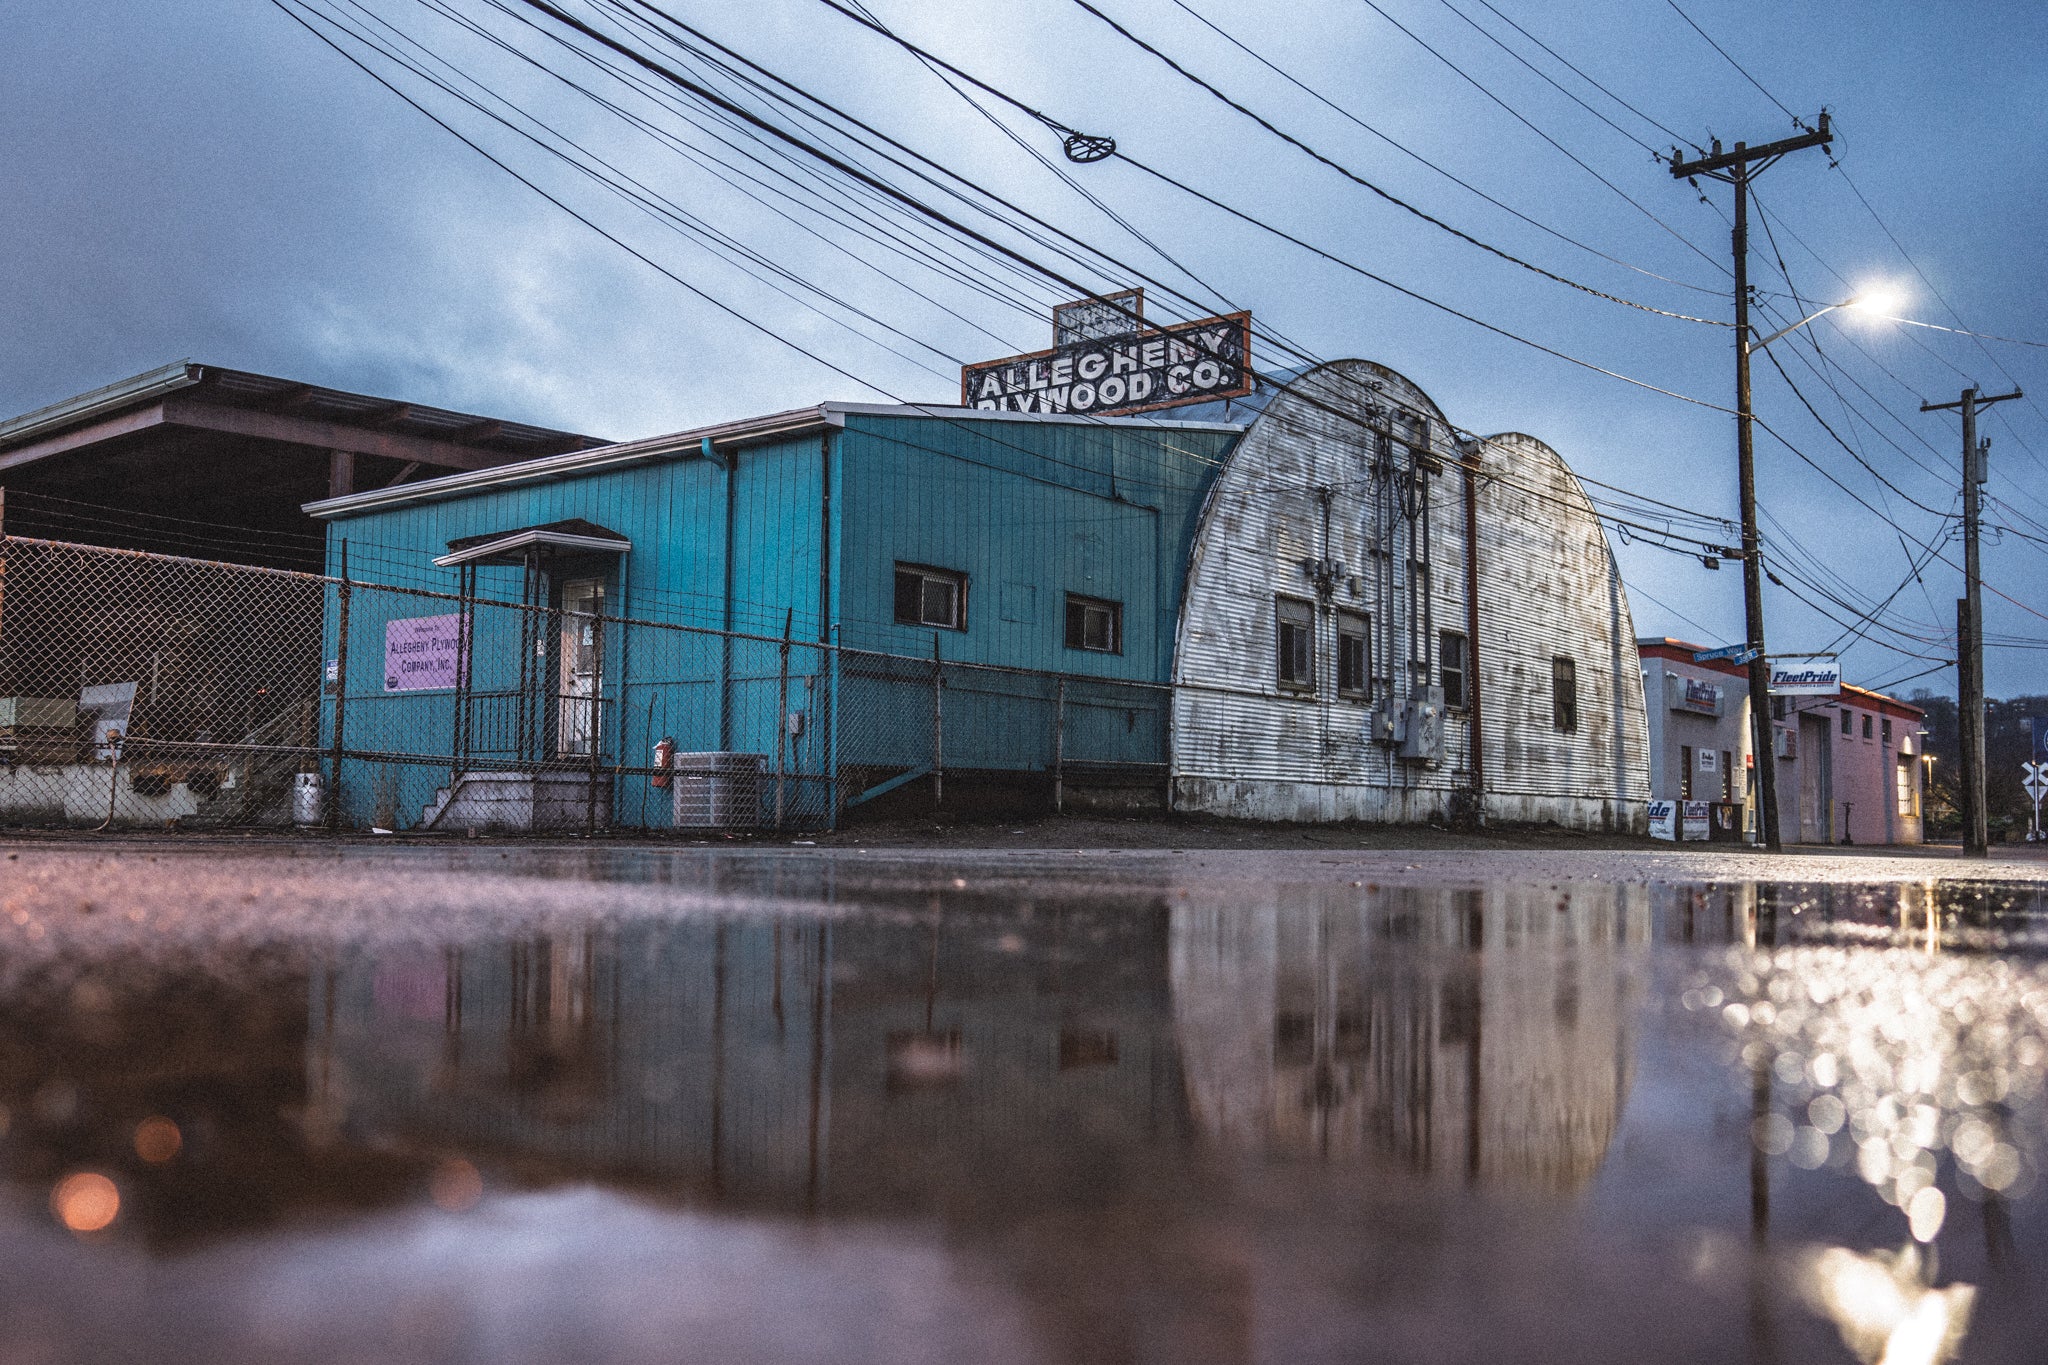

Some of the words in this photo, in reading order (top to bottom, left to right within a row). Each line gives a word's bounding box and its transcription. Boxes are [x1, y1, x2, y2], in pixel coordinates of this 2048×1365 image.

[979, 327, 1230, 399] ALLEGHENY
[1167, 359, 1230, 395] CO.
[1696, 651, 1724, 661] Spruce
[1773, 670, 1838, 682] FleetPride
